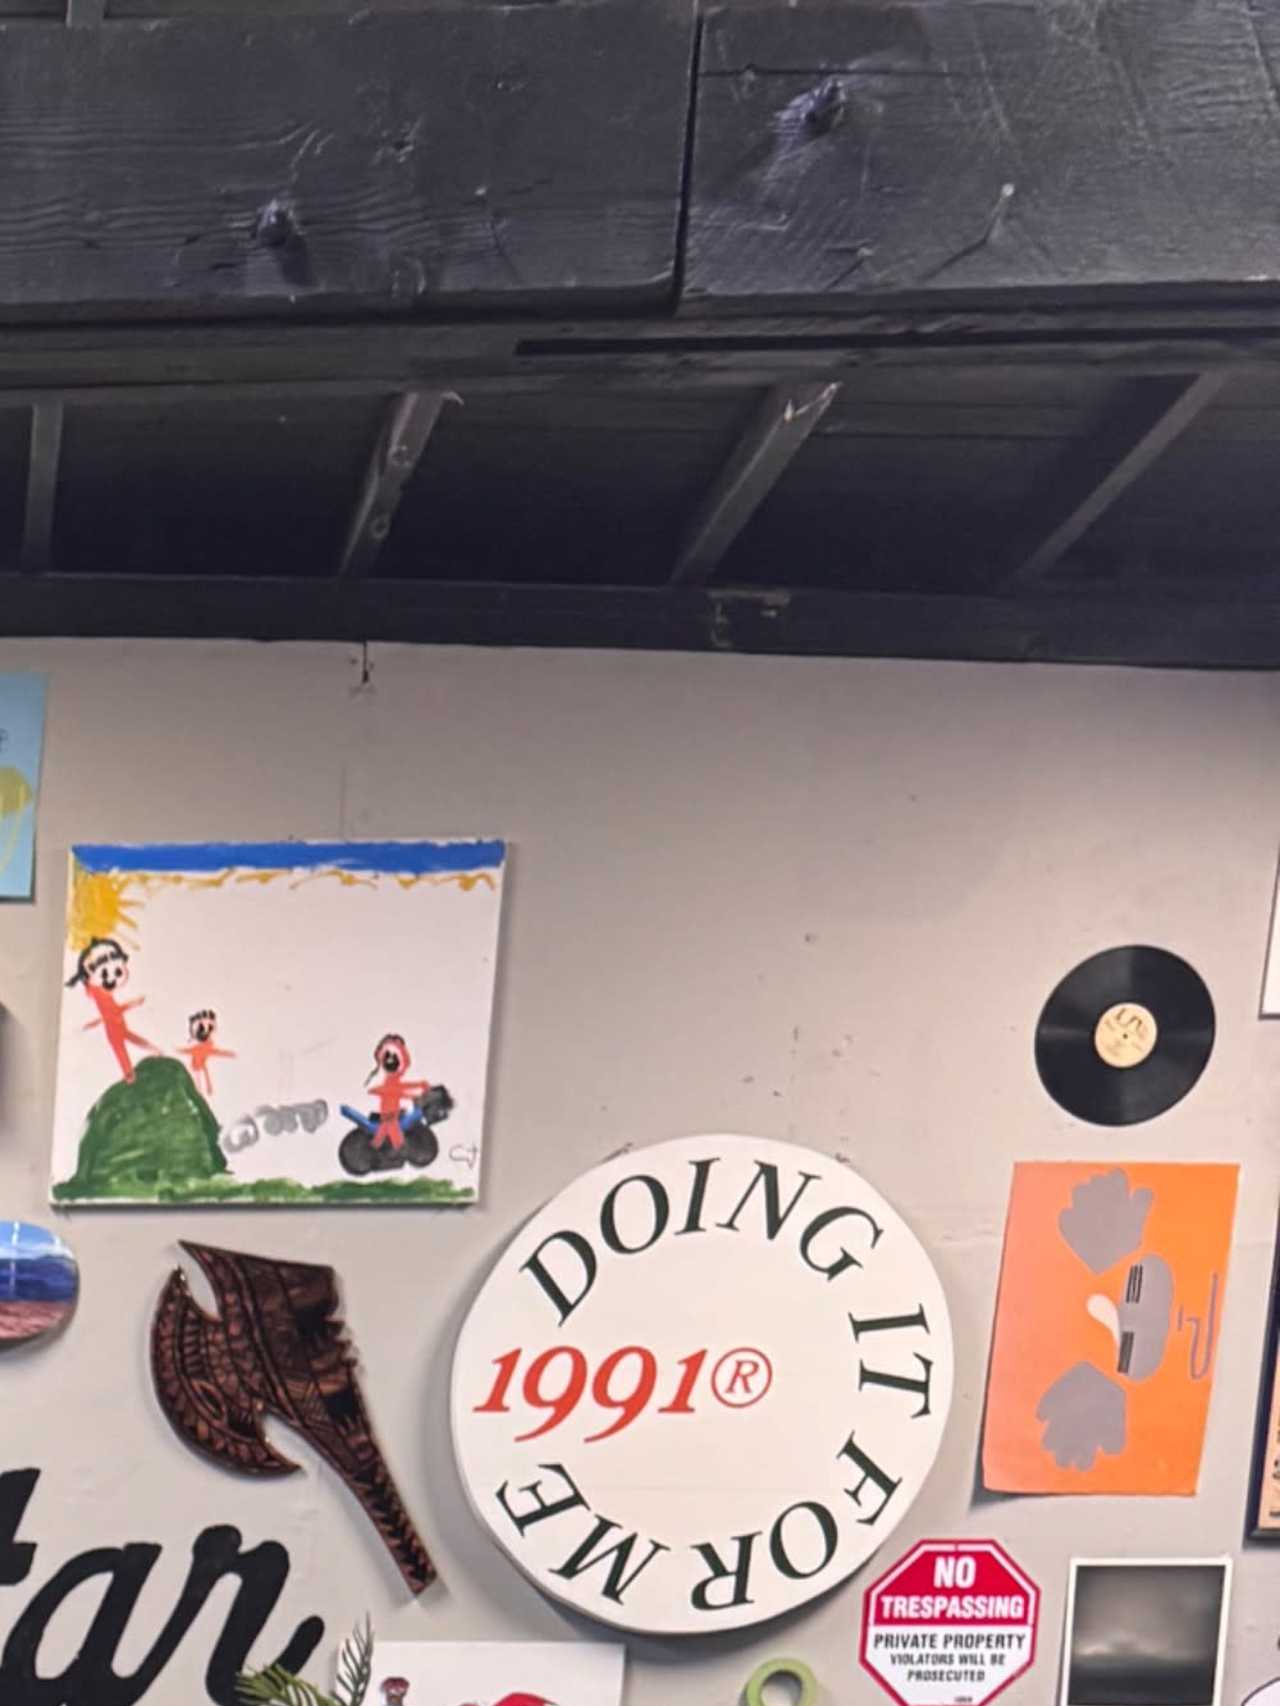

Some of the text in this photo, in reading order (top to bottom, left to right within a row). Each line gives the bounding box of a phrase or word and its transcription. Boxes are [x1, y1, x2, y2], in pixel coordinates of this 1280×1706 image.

[494, 1156, 934, 1613] DOING IT FOR ME
[933, 1555, 977, 1589] NO
[880, 1594, 1025, 1620] TRESPASSING
[873, 1633, 1027, 1650] PRIVATE PROPERTY
[890, 1653, 1006, 1666] VIOLATORS WILL BE
[906, 1669, 986, 1683] PROSECUTED
